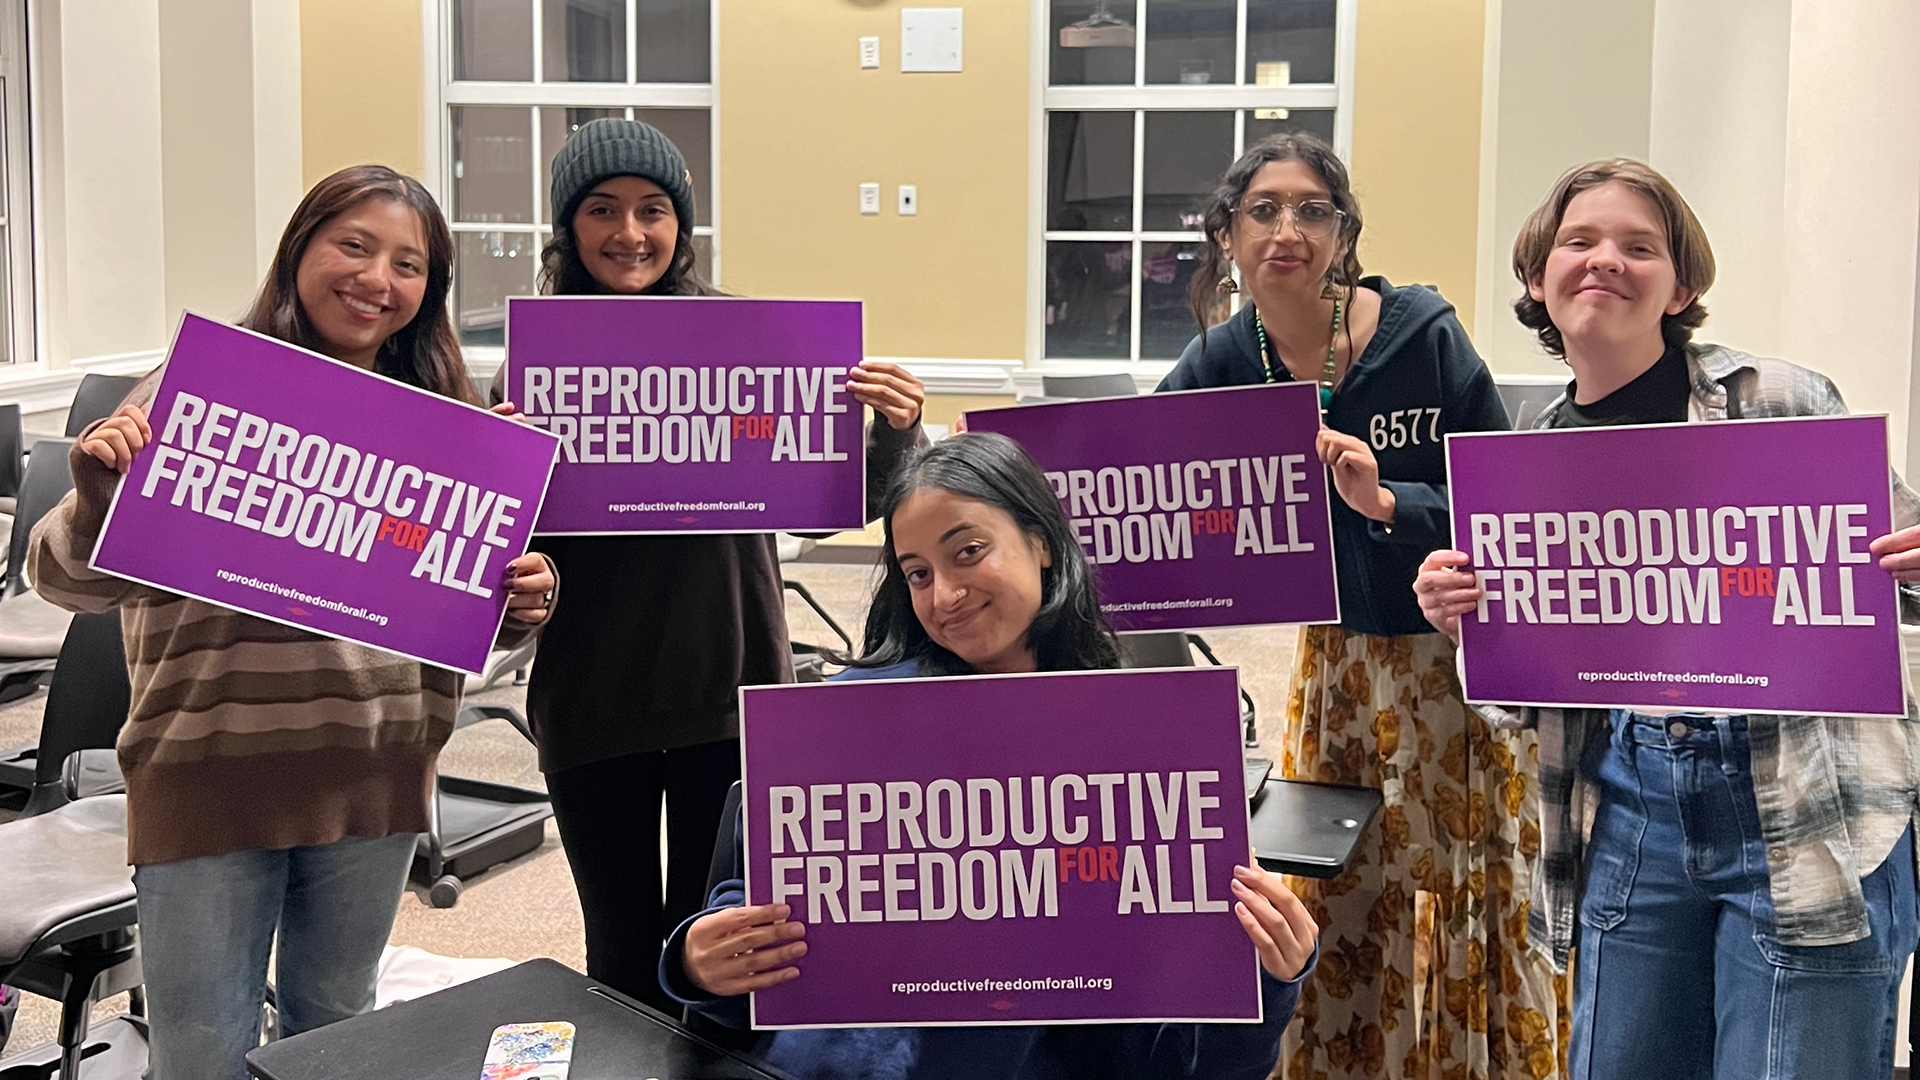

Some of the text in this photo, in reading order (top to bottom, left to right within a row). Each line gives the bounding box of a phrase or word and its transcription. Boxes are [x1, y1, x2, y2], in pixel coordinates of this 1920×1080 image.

[524, 366, 849, 415] REPRODUCTIVE
[525, 415, 848, 464] REEDOM FOR ALL
[1369, 408, 1442, 451] 6577
[161, 391, 522, 548] REPRODUCTIVE
[1044, 454, 1310, 518] PRODUCTIVE
[141, 445, 493, 598] FREEDOM FOR ALL
[608, 501, 766, 514] reproductivefreedomforall.org
[1068, 505, 1315, 565] EDOM FOR ALL
[1470, 504, 1871, 567] REPRODUCTIVE
[216, 569, 389, 626] reproductivefreedomforall.org
[1477, 566, 1876, 626] FREEDOM FOR ALL
[1577, 670, 1769, 687] reproductivefreedomforall.org
[769, 770, 1224, 853] REPRODUCTIVE
[771, 844, 1229, 924] FREEDOM FOR ALL
[891, 976, 1113, 994] reproductivefreedomforall.org
